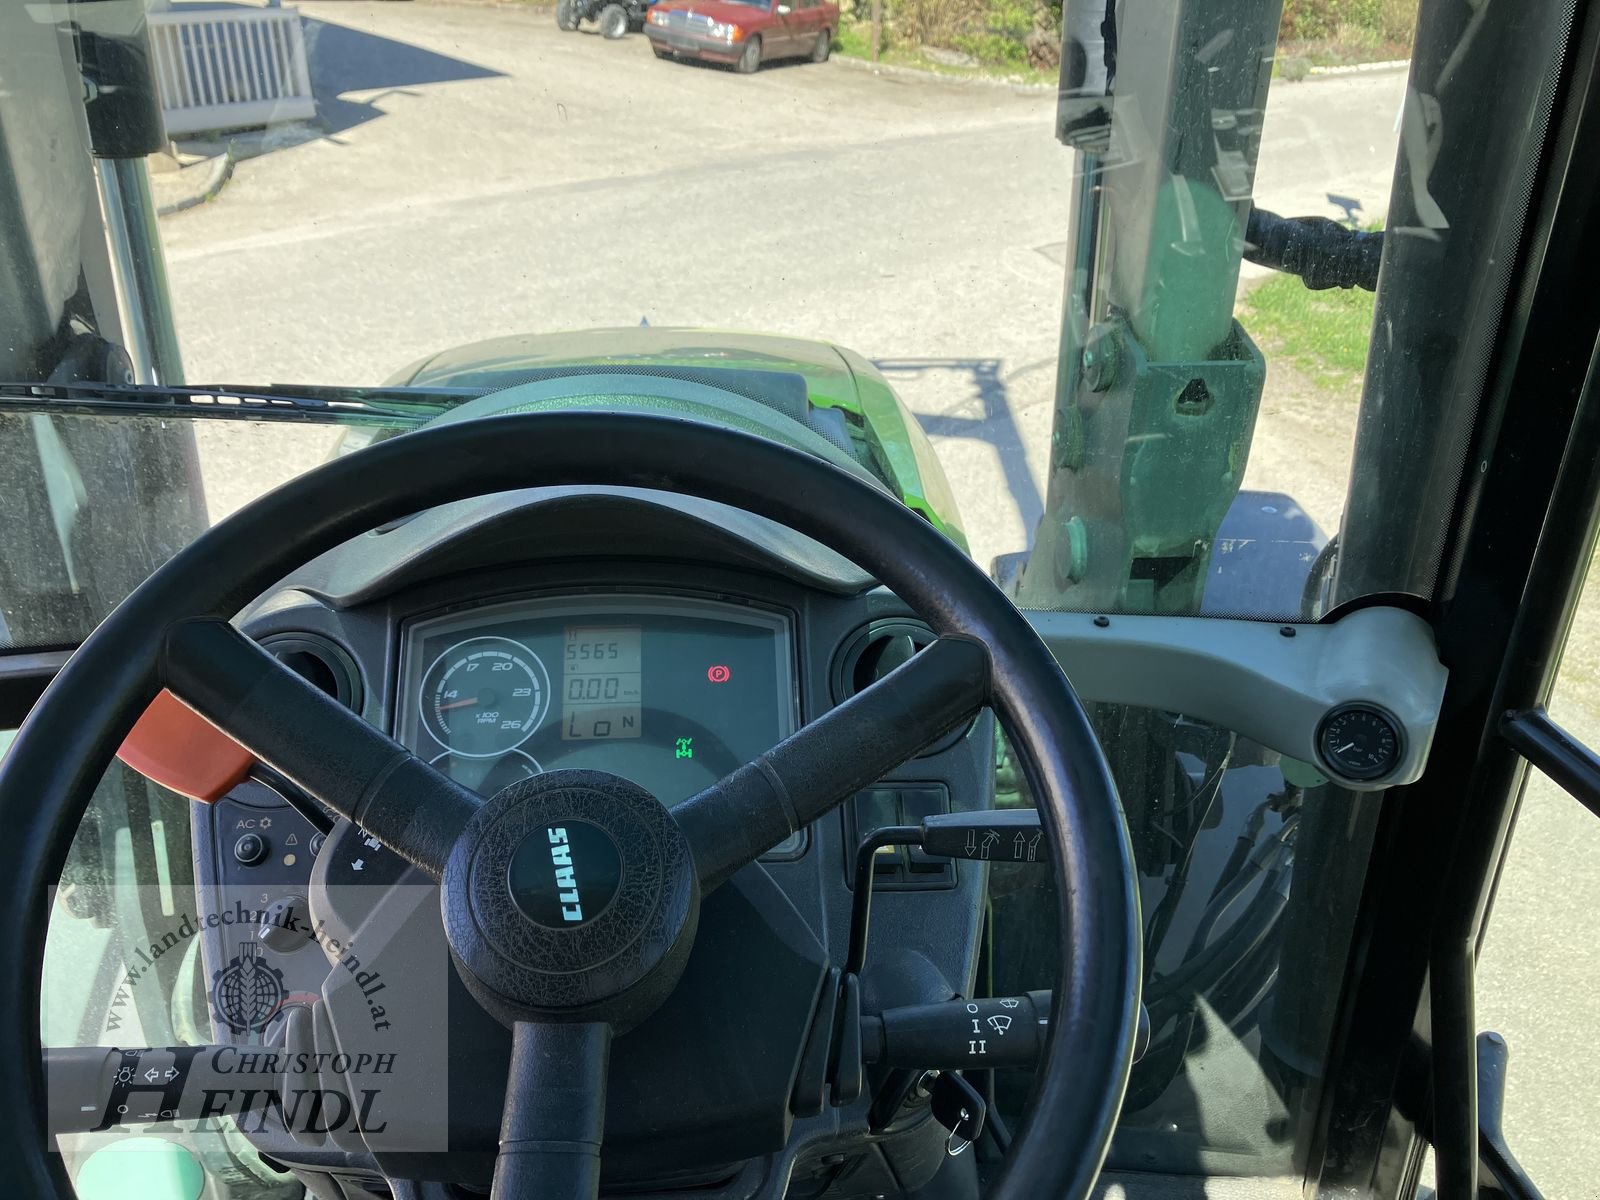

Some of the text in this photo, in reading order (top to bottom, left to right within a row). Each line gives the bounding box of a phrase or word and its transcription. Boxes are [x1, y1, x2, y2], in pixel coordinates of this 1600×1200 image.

[567, 643, 618, 660] 5565
[466, 663, 480, 672] 17
[491, 662, 513, 671] 20
[443, 690, 458, 699] 14
[512, 688, 531, 697] 23
[568, 678, 619, 700] 0.00
[500, 720, 521, 729] 26
[622, 715, 634, 728] N
[236, 819, 256, 830] AC
[547, 827, 583, 921] CLAAS
[260, 893, 269, 904] 3
